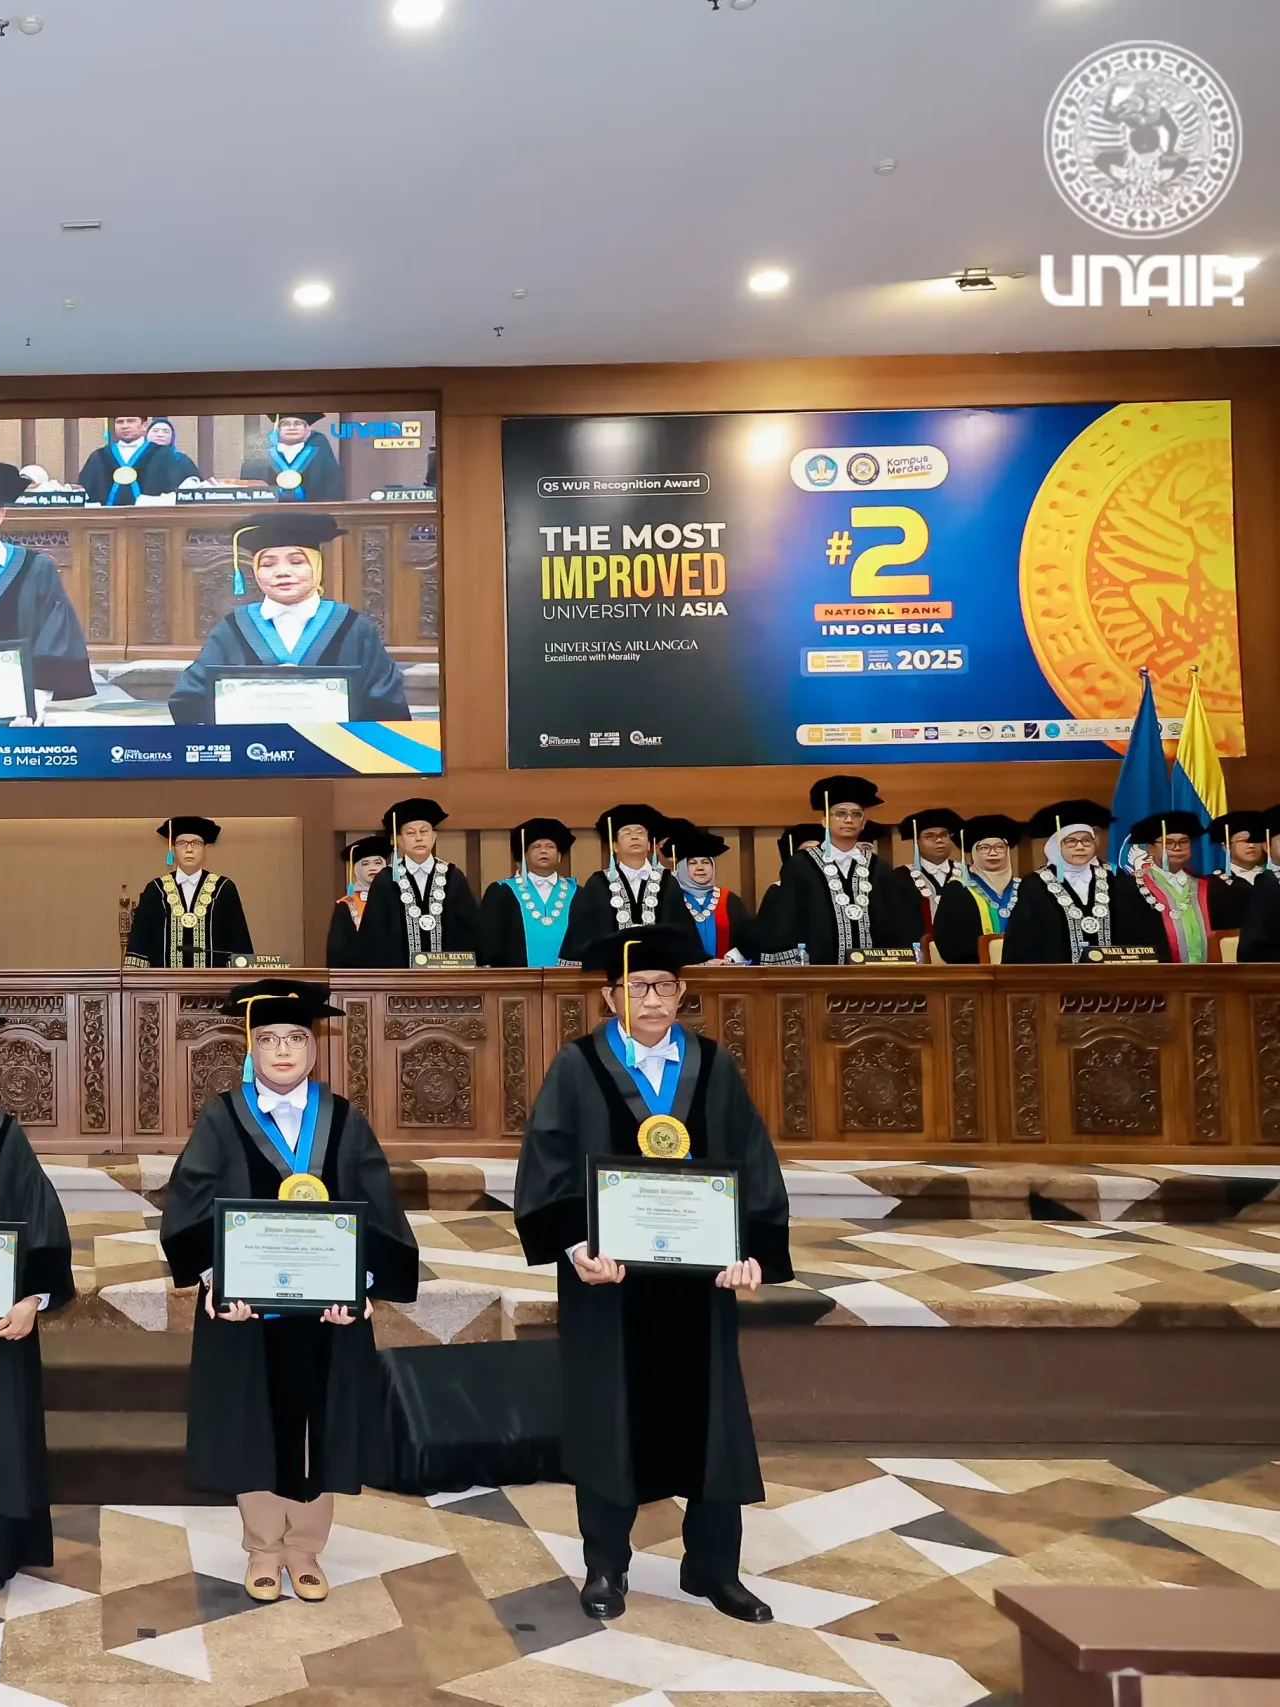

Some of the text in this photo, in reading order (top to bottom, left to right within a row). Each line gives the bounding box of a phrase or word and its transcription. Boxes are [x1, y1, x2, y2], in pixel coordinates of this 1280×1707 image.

[404, 425, 419, 434] TV
[888, 455, 928, 467] Kampus
[888, 462, 932, 475] Merdeka
[543, 478, 700, 492] QS WUR Recognition Award
[386, 490, 434, 500] REKTOR
[539, 522, 726, 552] THE MOST
[826, 506, 930, 597] #2
[540, 552, 727, 600] IMPROVED
[543, 602, 729, 620] UNIVERSITY IN ASIA
[824, 606, 942, 616] NATIONAL RANK
[822, 622, 944, 636] INDONESIA
[544, 640, 699, 653] UNIVERSITAS AIRLANGGA
[544, 652, 640, 662] Excellence with Morality
[896, 649, 964, 670] 2025
[868, 662, 893, 670] ASIA
[13, 746, 78, 754] AIRLANGGA
[3, 756, 78, 766] 8 Mei 2025
